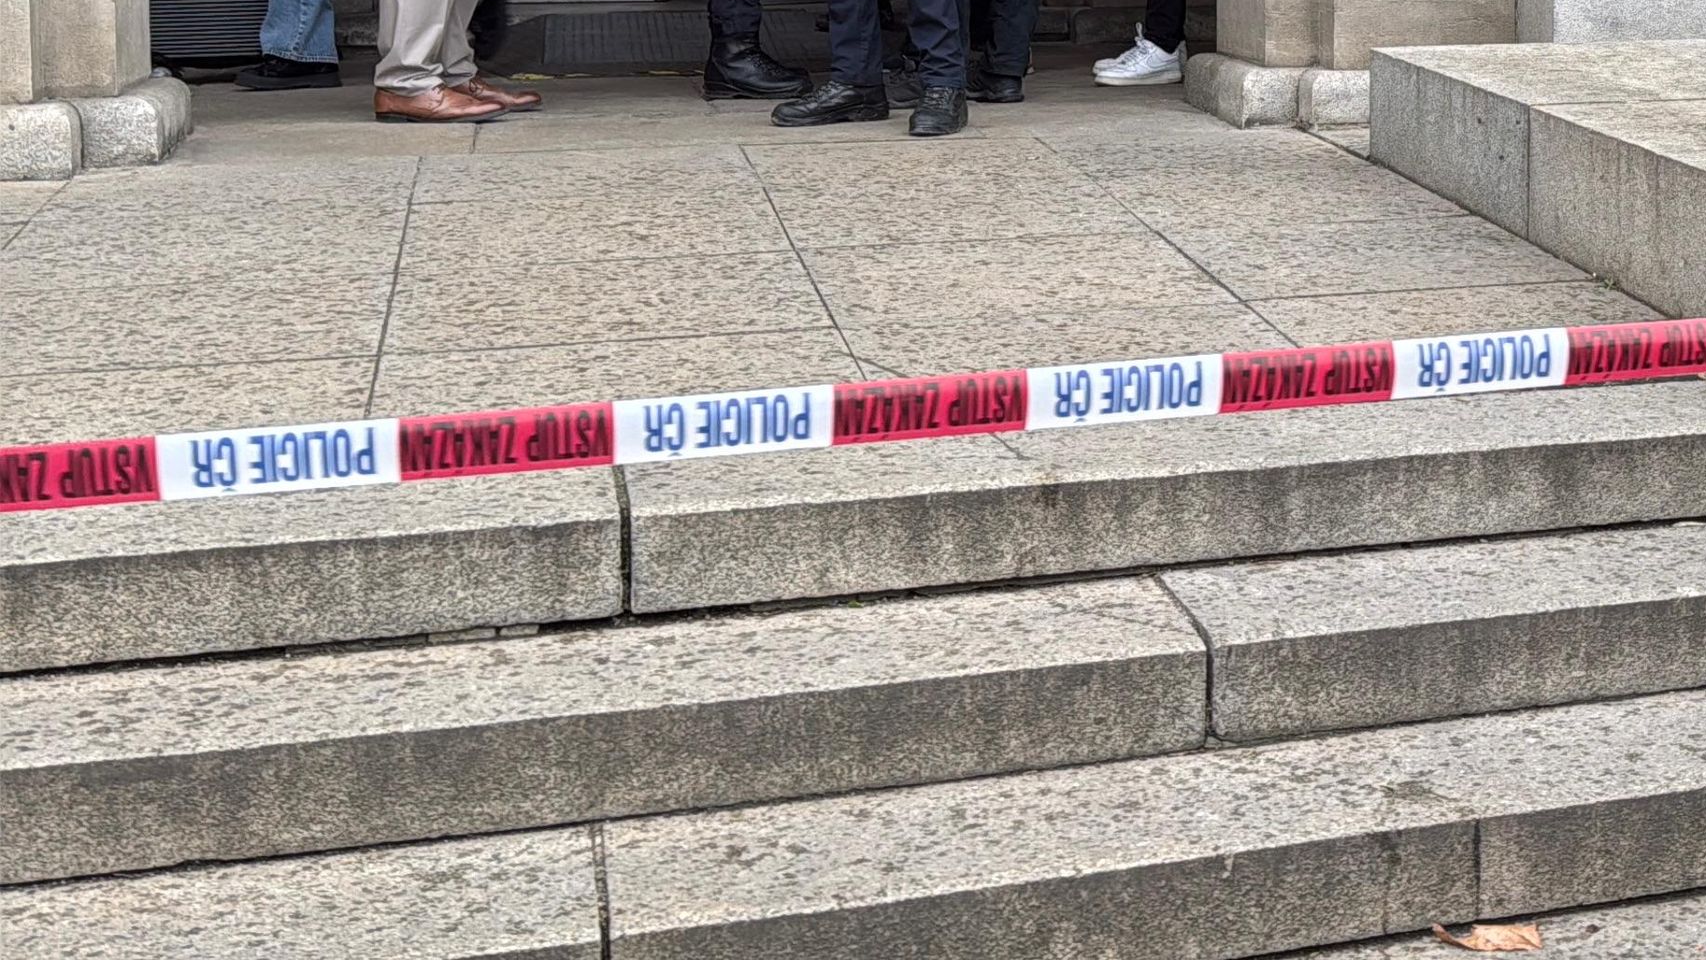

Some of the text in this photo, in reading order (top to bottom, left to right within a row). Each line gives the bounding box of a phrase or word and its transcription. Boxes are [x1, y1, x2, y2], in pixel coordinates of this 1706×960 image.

[1324, 347, 1391, 396] VSTUP
[1417, 333, 1551, 392] POLICIE ČR
[948, 376, 1022, 427] VSTUP
[1055, 360, 1203, 424] POLICIE ČR
[527, 409, 609, 462] VSTUP
[643, 391, 811, 457] POLICIE ČR
[60, 444, 156, 498] VSTUP
[190, 425, 377, 493] POLICIE ČR
